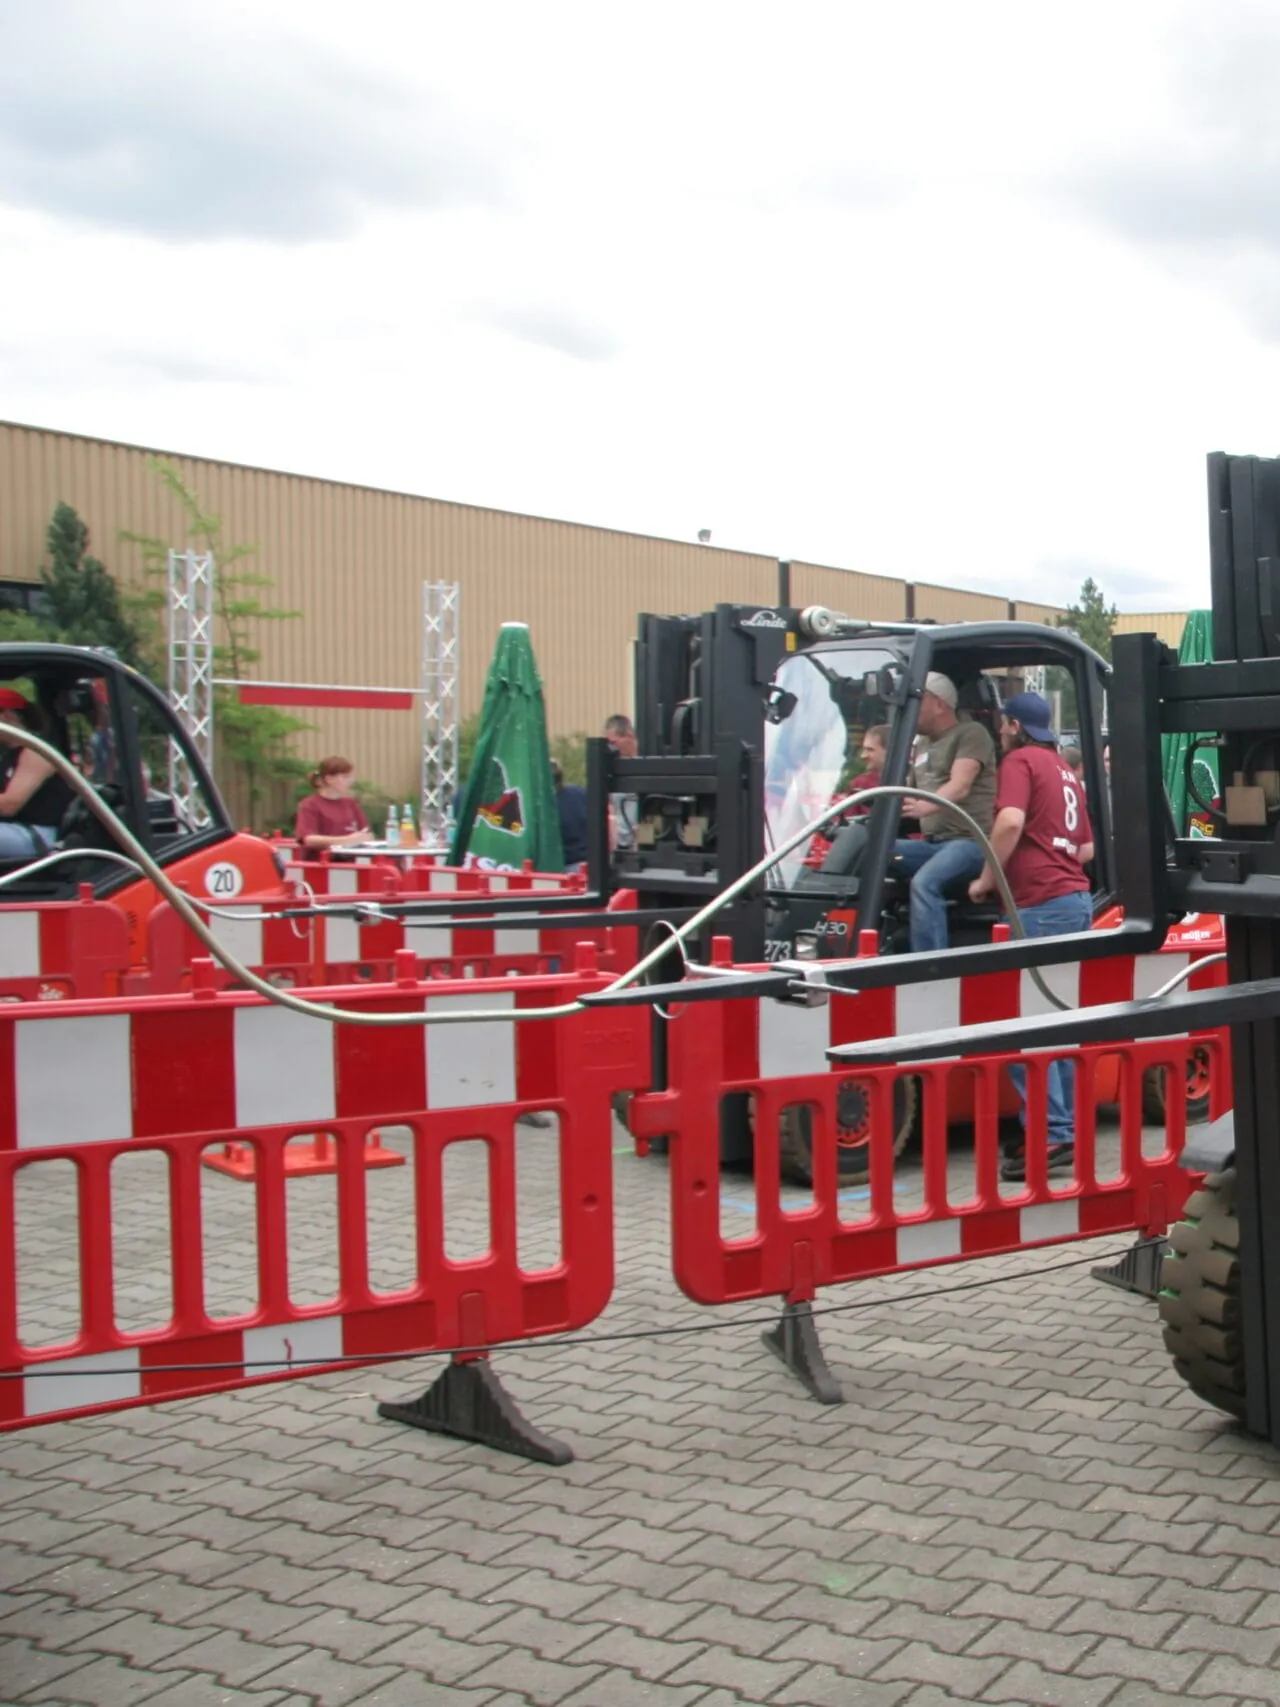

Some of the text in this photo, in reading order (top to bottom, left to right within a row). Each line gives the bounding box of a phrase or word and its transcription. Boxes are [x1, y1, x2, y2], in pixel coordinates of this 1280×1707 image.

[740, 609, 787, 629] Linde
[1063, 785, 1078, 831] 8
[212, 869, 235, 893] 20
